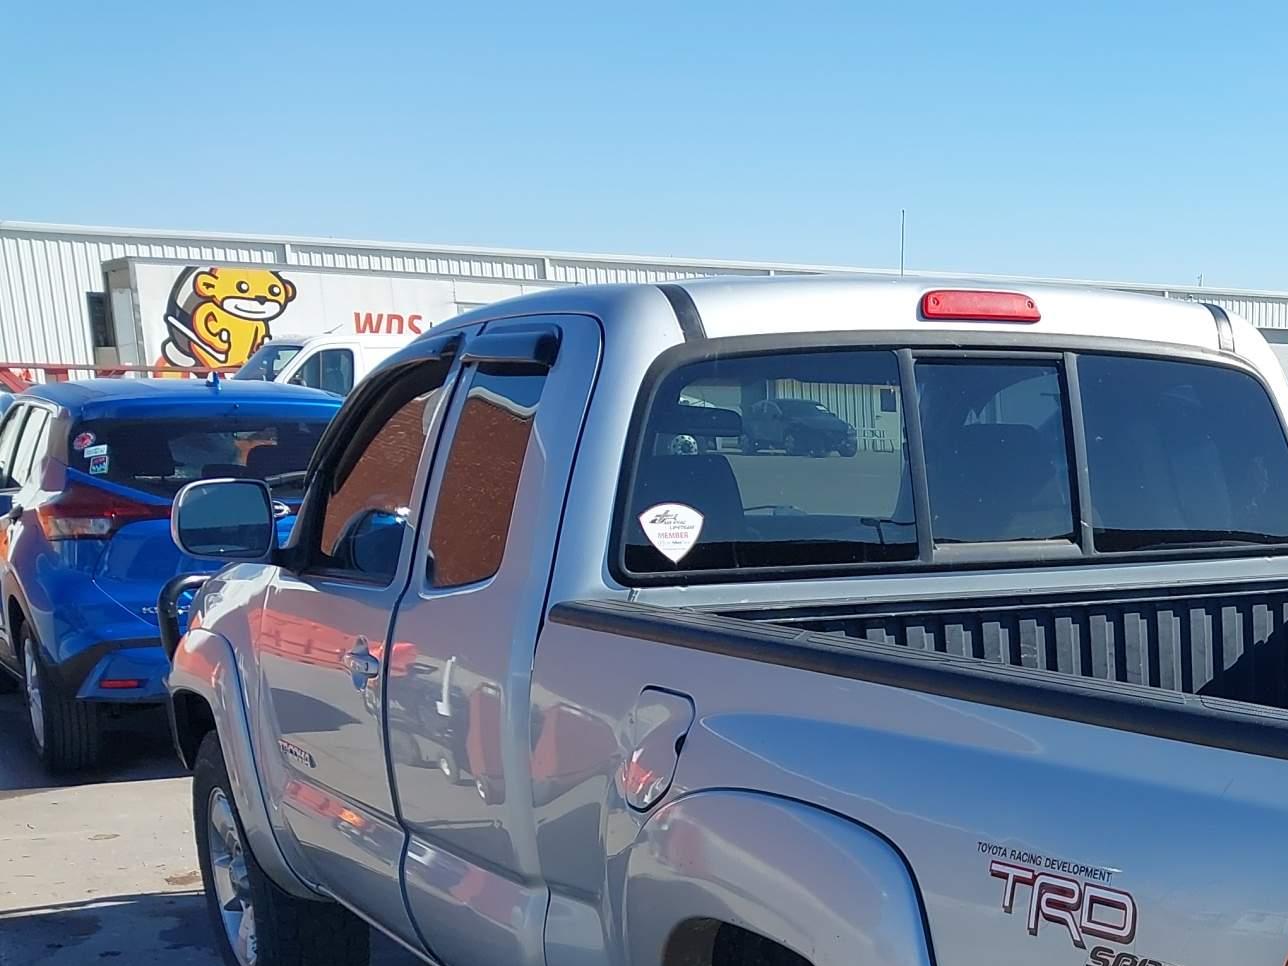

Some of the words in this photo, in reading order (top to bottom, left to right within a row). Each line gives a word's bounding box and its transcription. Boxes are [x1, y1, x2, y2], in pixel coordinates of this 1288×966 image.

[976, 841, 1008, 858] TOYOTA
[1009, 849, 1042, 867] RACING
[1044, 857, 1113, 883] DEVELOPMENT
[989, 859, 1138, 950] TRD
